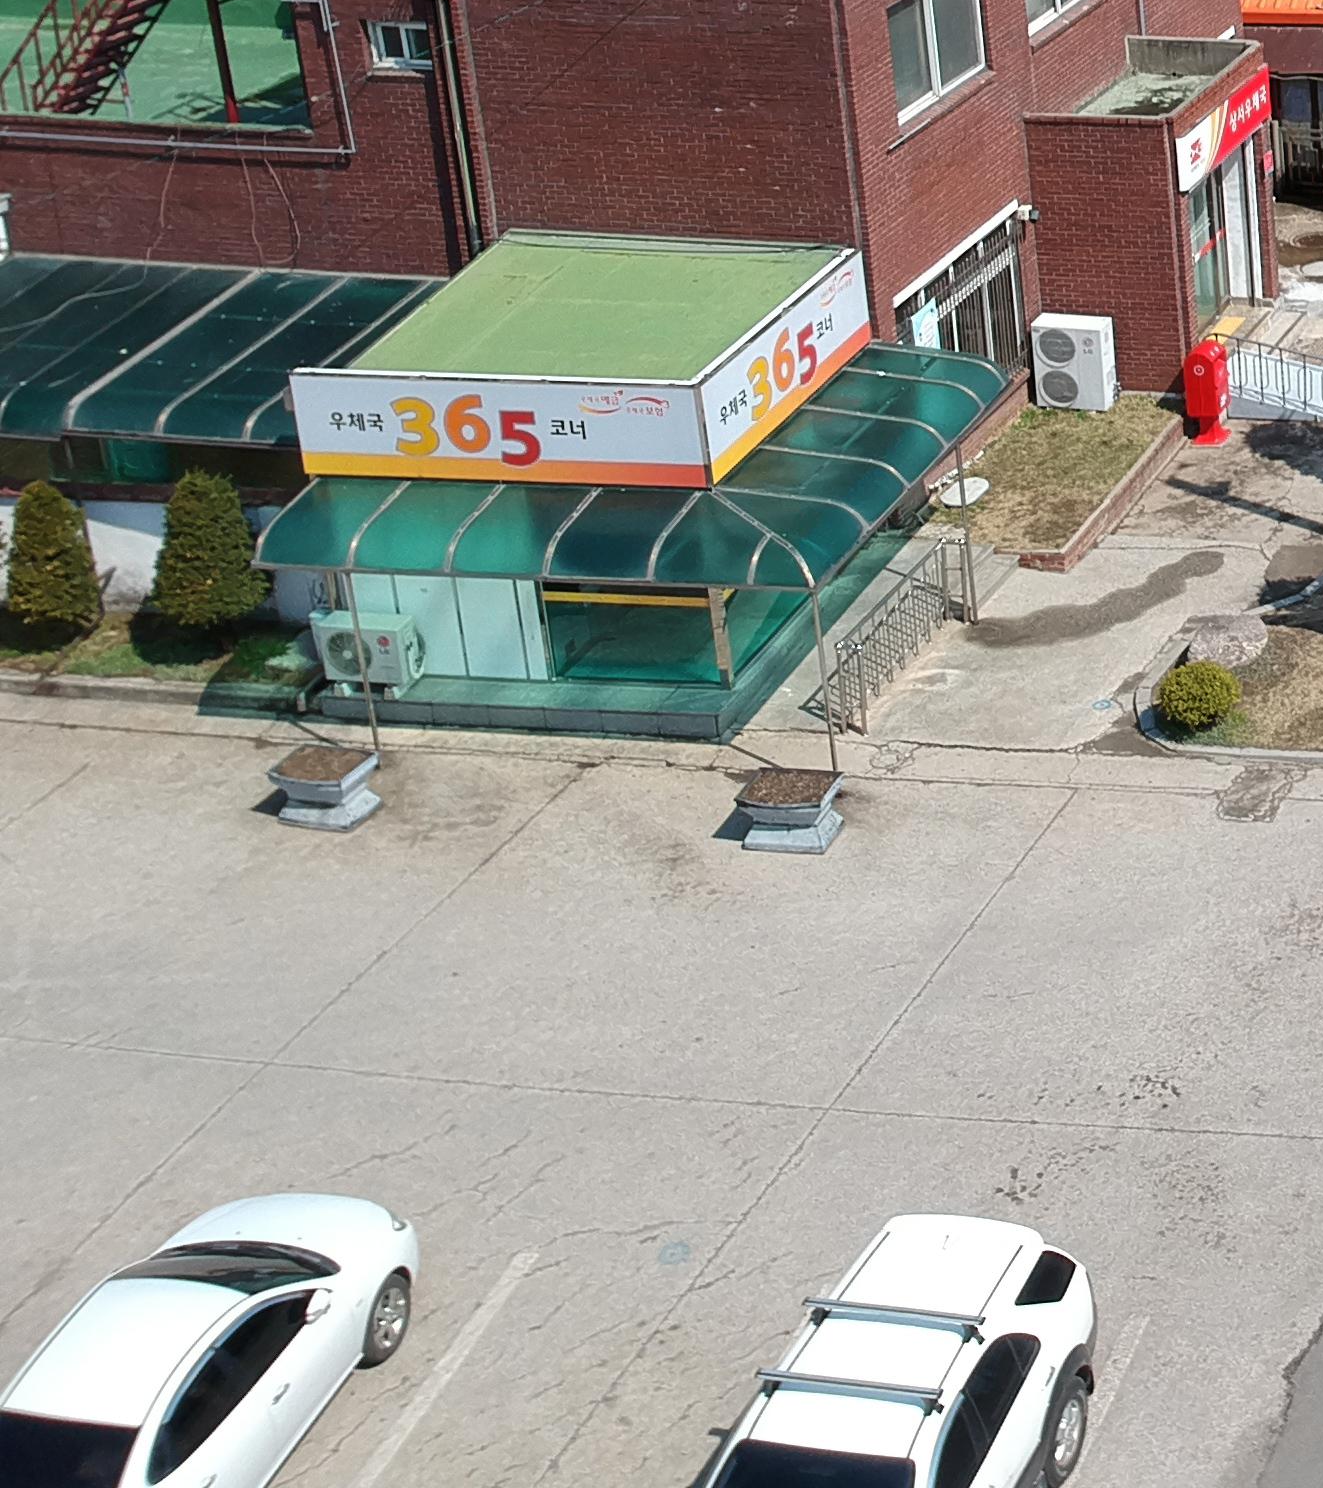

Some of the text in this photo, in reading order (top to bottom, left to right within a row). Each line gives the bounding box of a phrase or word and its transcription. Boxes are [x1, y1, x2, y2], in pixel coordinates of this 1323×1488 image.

[1229, 84, 1267, 132] 상서우체국
[719, 313, 834, 426] 우체국 365 코너
[328, 394, 587, 467] 우체국 365 코너
